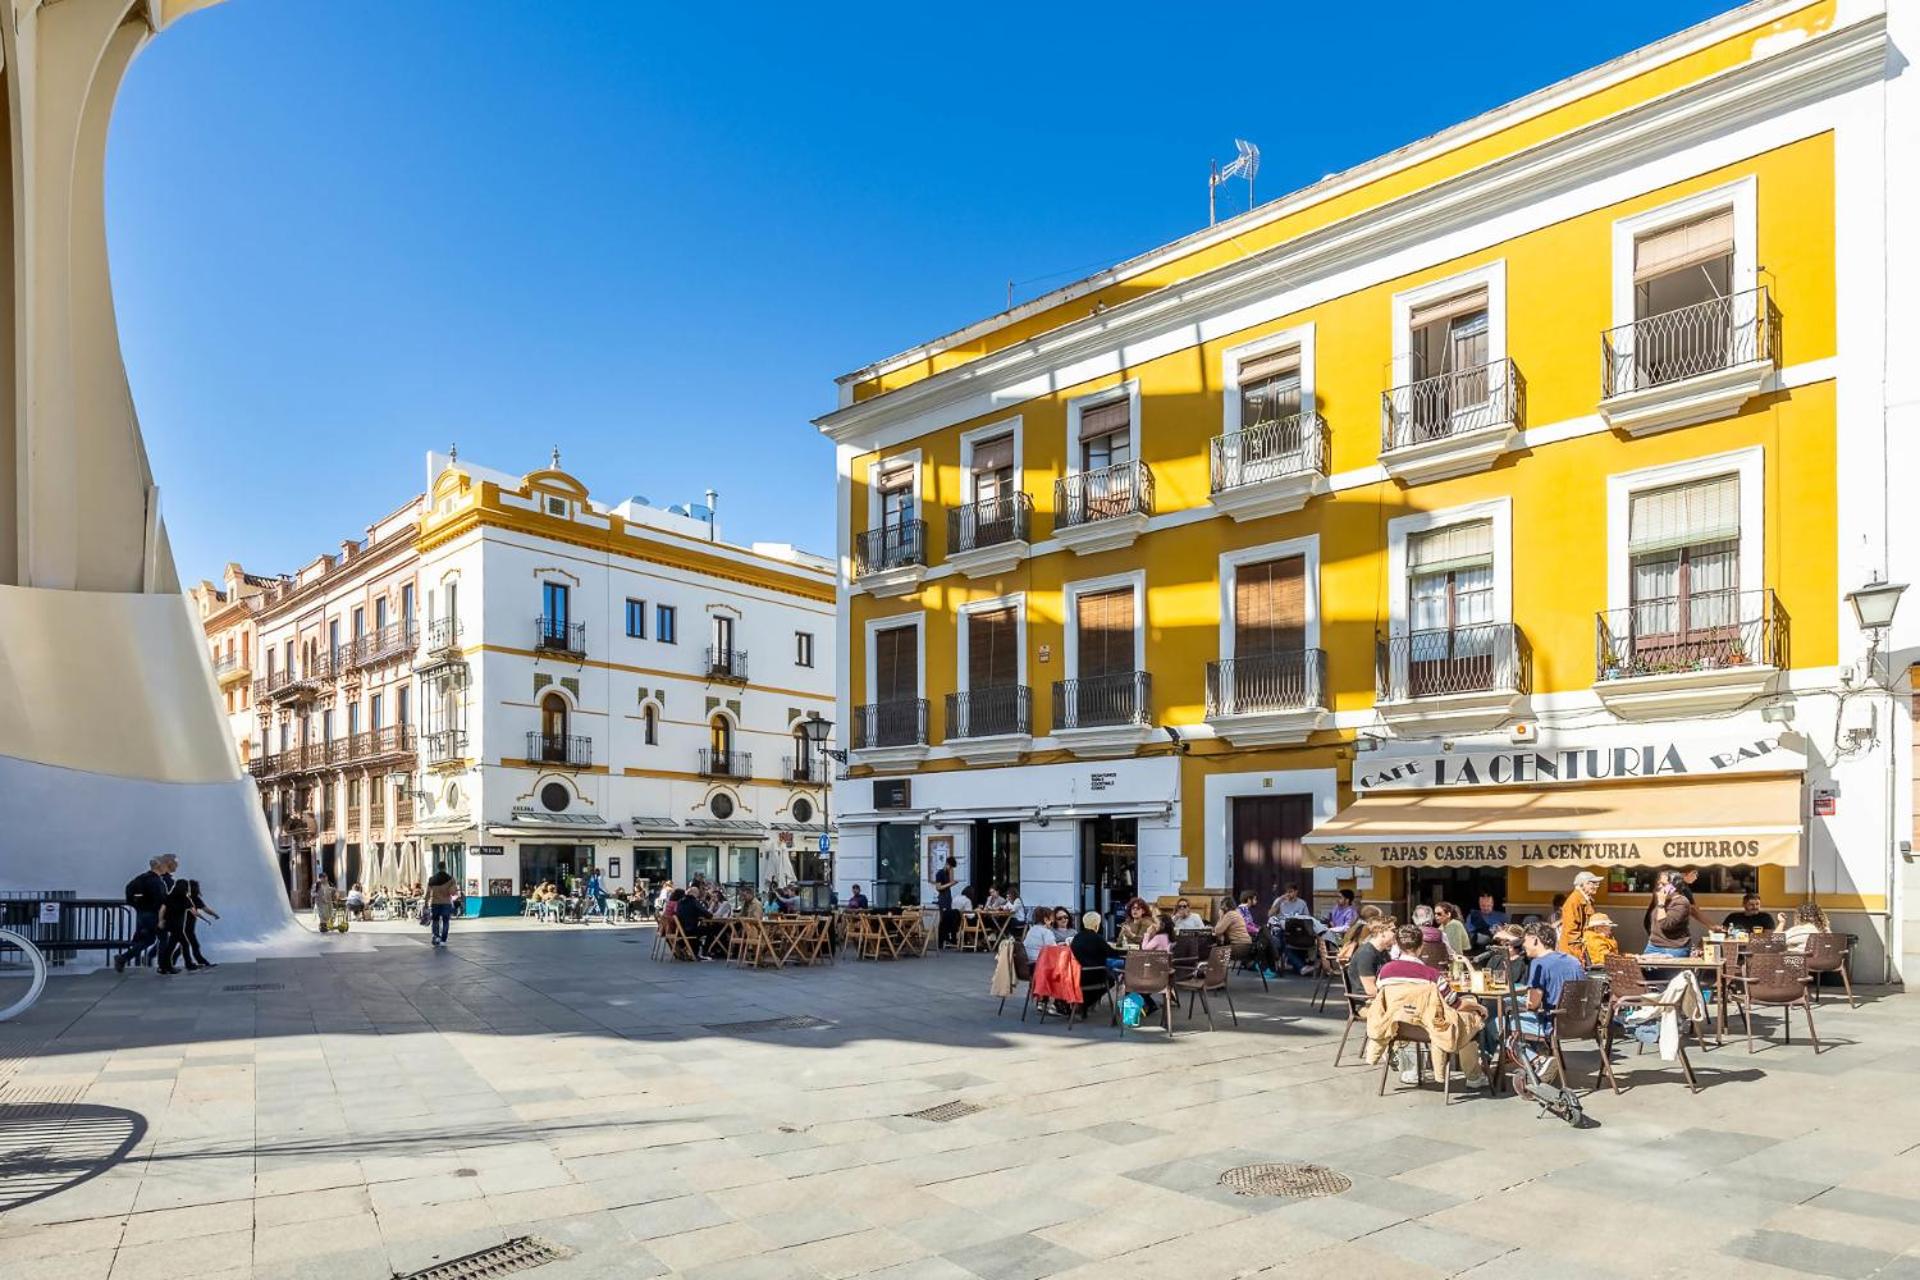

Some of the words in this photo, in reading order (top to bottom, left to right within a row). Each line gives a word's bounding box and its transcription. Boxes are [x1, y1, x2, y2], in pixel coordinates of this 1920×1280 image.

[1360, 761, 1424, 788] CAFE
[1435, 757, 1481, 786] LA
[1489, 743, 1688, 783] CENTURIA
[1379, 846, 1428, 861] TAPAS
[1434, 845, 1508, 861] CASERAS
[1521, 845, 1544, 860] LA
[1547, 843, 1641, 860] CENTURIA
[1663, 840, 1760, 858] CHURROS
